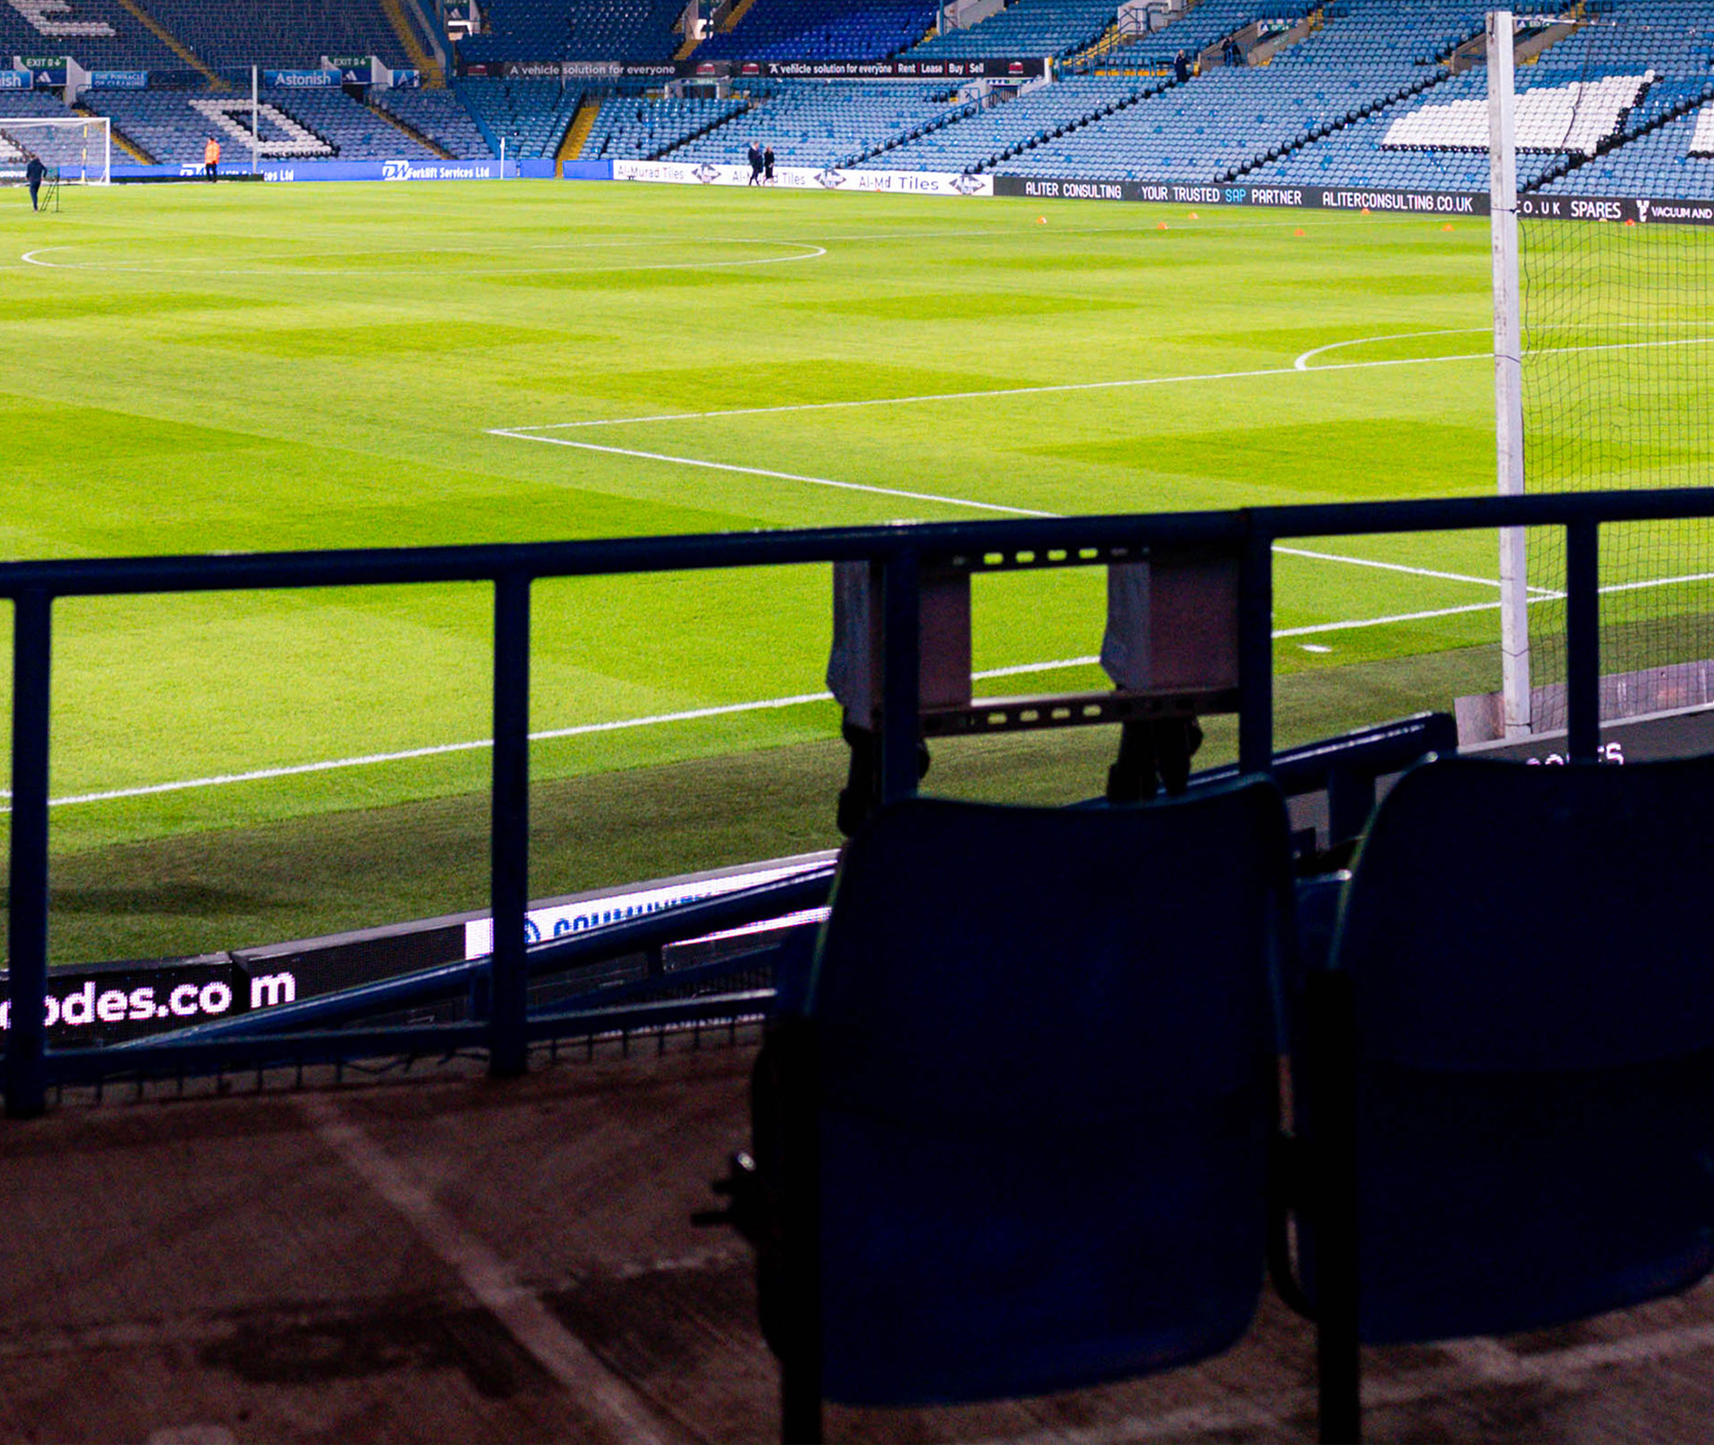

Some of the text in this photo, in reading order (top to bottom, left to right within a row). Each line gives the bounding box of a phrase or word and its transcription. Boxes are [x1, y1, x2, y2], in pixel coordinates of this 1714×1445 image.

[26, 59, 46, 67] EXIT
[769, 64, 779, 74] A
[780, 64, 812, 74] vehicle
[813, 64, 845, 74] solution
[846, 63, 858, 74] for
[858, 65, 893, 76] everyone
[897, 62, 916, 73] Rent
[920, 62, 943, 73] Lease
[948, 62, 964, 75] Buy
[969, 62, 985, 73] Sell
[510, 65, 676, 77] A vehicle solution for everyone
[274, 71, 332, 88] Astonish
[439, 166, 474, 178] Services
[475, 165, 490, 178] Ltd
[617, 165, 660, 178] Al-Murad
[663, 167, 684, 180] Tiles
[781, 171, 806, 185] Tiles
[898, 175, 940, 191] Tiles
[1025, 181, 1302, 206] ALITER CONSULTING YOUR TRUSTED SAP PARTNER
[1322, 191, 1473, 213] ALITERCONSULTING.CO.UK
[1570, 201, 1622, 219] SPARES
[1651, 206, 1691, 218] VACUUM
[1691, 208, 1713, 219] AND
